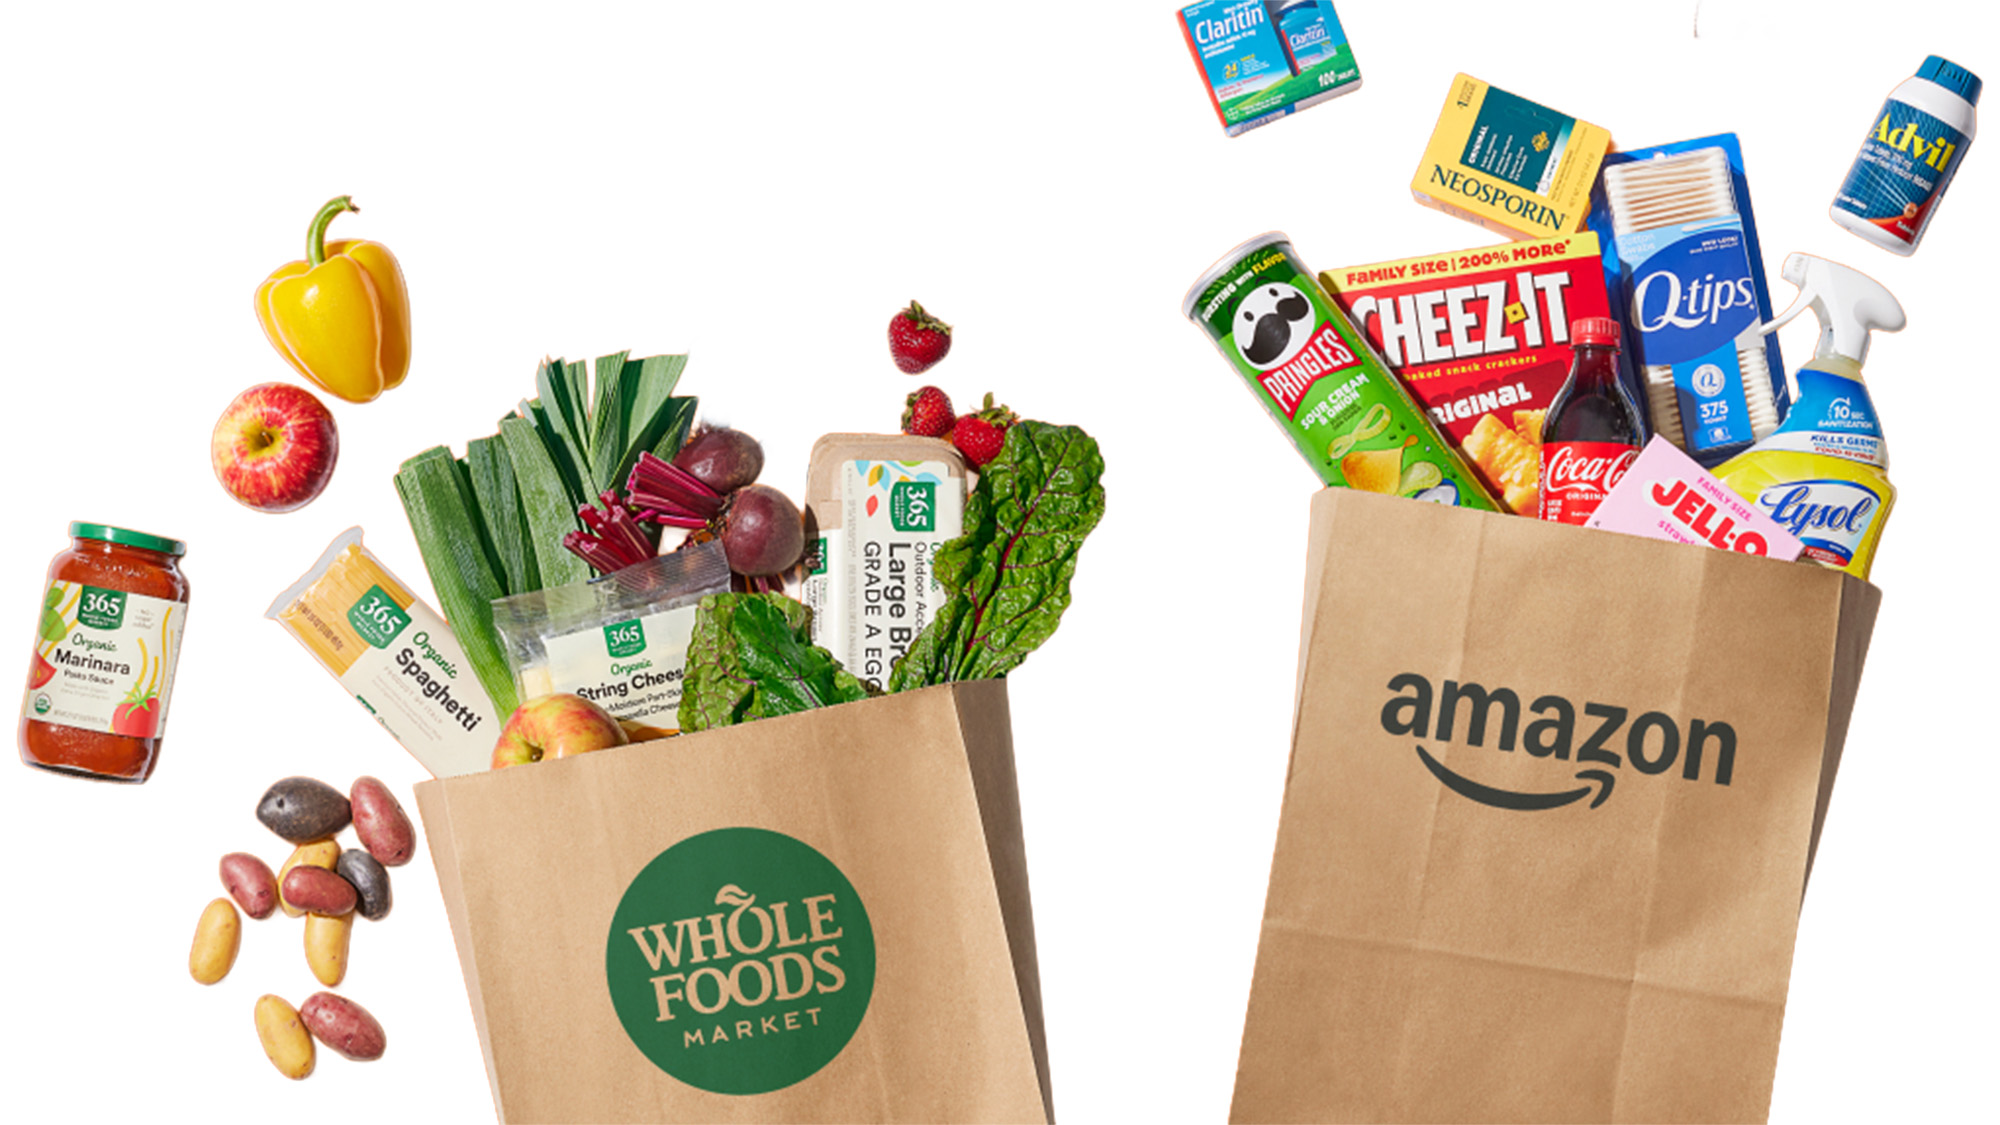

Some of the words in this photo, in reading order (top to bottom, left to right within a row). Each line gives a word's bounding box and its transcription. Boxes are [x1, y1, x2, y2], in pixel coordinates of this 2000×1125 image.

[1195, 7, 1263, 44] Claritin
[1290, 28, 1325, 47] Claritin
[1318, 70, 1335, 87] 100
[1869, 113, 1956, 173] Advil
[1430, 164, 1566, 231] NEOSPORIN
[1459, 250, 1509, 269] 200%
[1202, 282, 1237, 322] BURSTING
[1251, 252, 1287, 275] FLAVOR
[1631, 270, 1753, 333] Q-tips
[1262, 328, 1354, 413] PRINGLES
[1447, 362, 1481, 376] snack
[1485, 355, 1537, 370] crackers
[1301, 403, 1329, 430] SOUR
[1328, 373, 1370, 404] CREAM
[1319, 414, 1329, 425] &
[1327, 390, 1360, 418] ONION
[1427, 381, 1532, 424] RIGINAL
[1700, 400, 1729, 419] 375
[1834, 405, 1850, 419] 10
[1810, 435, 1844, 444] KILLS
[1546, 446, 1640, 493] Coca-C
[906, 485, 929, 527] 365
[1652, 480, 1768, 557] JELL-O
[1697, 476, 1732, 505] FAMILY
[1730, 500, 1752, 522] SIZE
[1760, 486, 1872, 536] Lysol
[1657, 520, 1695, 545] straw
[864, 541, 882, 616] GRADE
[883, 543, 911, 619] Large
[914, 542, 927, 597] Outdoor
[83, 593, 121, 617] 365
[360, 596, 402, 635] 365
[915, 601, 927, 632] Acce
[72, 632, 118, 652] Organic
[609, 624, 641, 648] 365
[865, 624, 882, 639] A
[889, 626, 911, 669] Bro
[54, 648, 131, 676] Marinara
[412, 631, 458, 679] Organic
[610, 658, 653, 676] Organic
[865, 647, 882, 694] EGG
[64, 669, 86, 681] Pasta
[87, 673, 114, 685] Sauce
[395, 648, 482, 732] Spaghetti
[577, 681, 628, 701] String
[631, 667, 684, 691] Chees
[1380, 672, 1737, 786] amazon
[627, 893, 843, 971] WHOLE
[650, 944, 846, 1022] FOODS
[683, 1007, 822, 1048] MARKET
